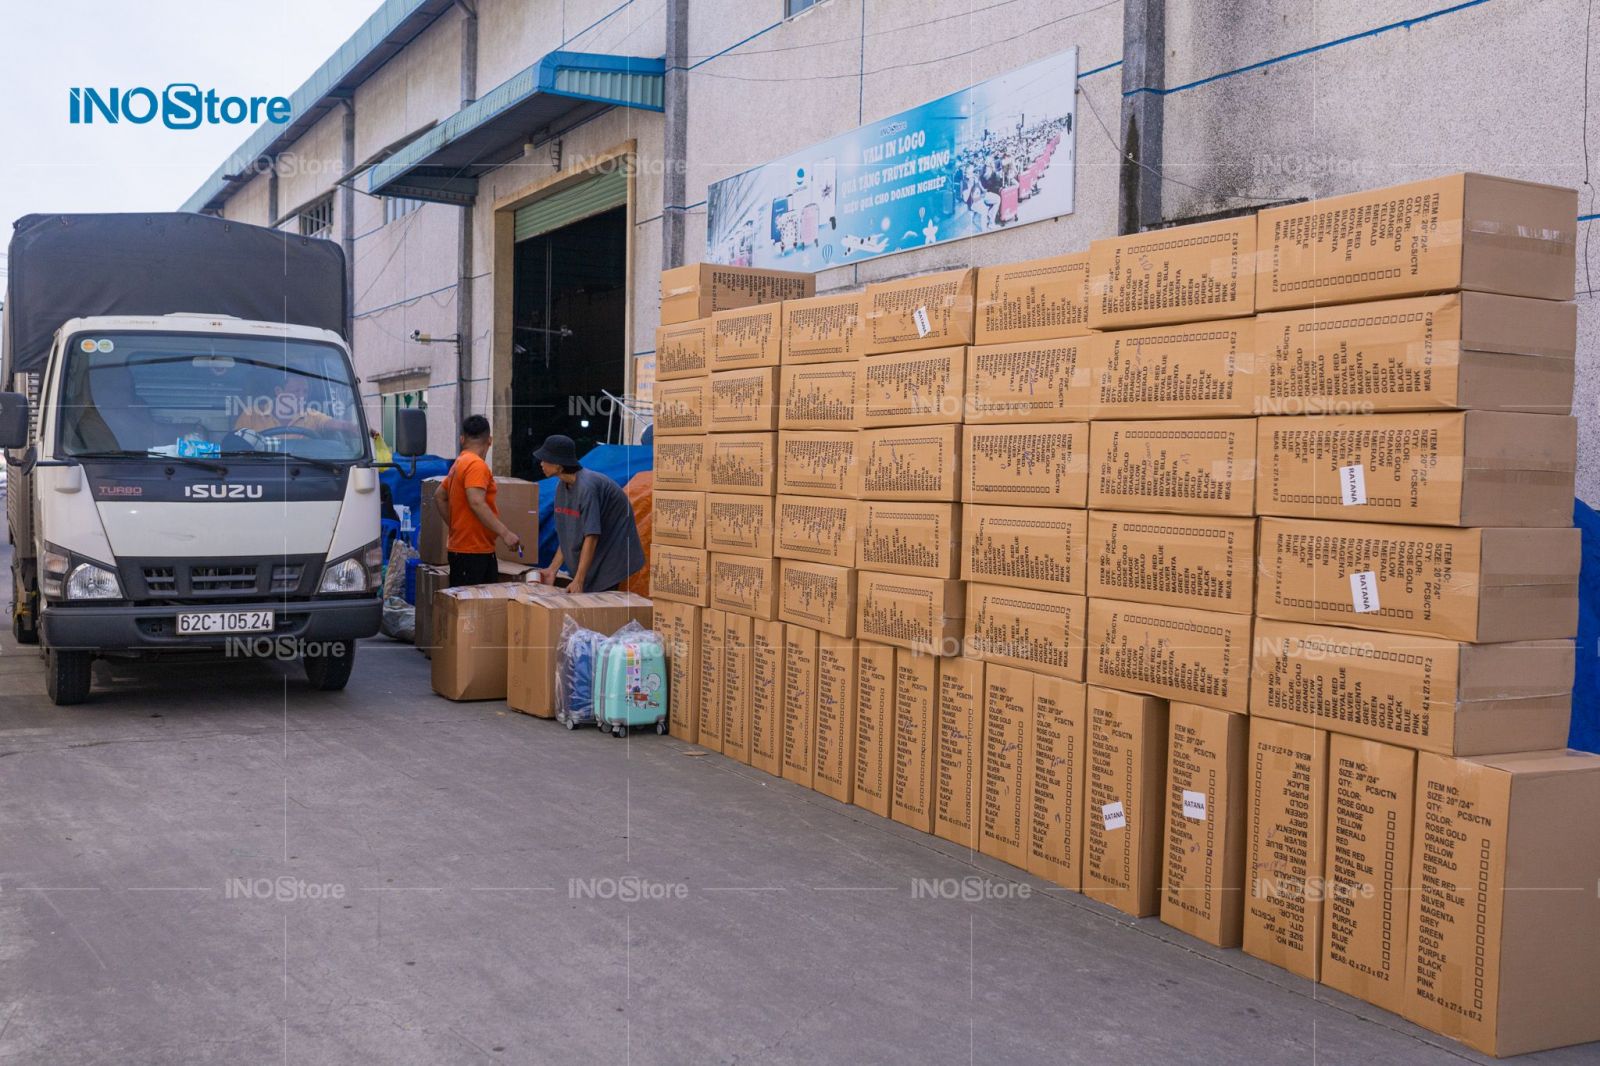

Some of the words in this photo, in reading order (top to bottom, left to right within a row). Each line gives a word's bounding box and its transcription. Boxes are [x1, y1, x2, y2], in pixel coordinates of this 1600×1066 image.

[863, 143, 884, 165] VALI
[885, 139, 897, 159] IN
[898, 129, 926, 154] LOGO
[874, 192, 890, 205] CHO
[890, 183, 916, 201] DOANH
[1431, 193, 1439, 216] ITEM
[1371, 204, 1379, 246] EMERALD
[1379, 202, 1387, 239] YELLOW
[1387, 201, 1396, 239] ORANGE
[99, 486, 142, 495] TURBO
[185, 484, 262, 498] ISUZU
[1348, 467, 1358, 504] RATANA
[1444, 544, 1452, 566] ITEM
[1360, 574, 1371, 611] RATANA
[1423, 581, 1431, 622] PCS/CTN
[180, 613, 271, 632] 62C-105.24
[1339, 758, 1354, 769] ITEM
[1366, 785, 1396, 800] PCS/CTN
[1428, 780, 1445, 792] ITEM
[1184, 801, 1205, 811] RATANA
[1337, 797, 1355, 809] ROSE
[1356, 802, 1375, 814] GOLD
[1104, 811, 1124, 822] RATANA
[1337, 807, 1364, 821] ORANGE
[1457, 810, 1491, 828] PCS/CTN
[1337, 817, 1363, 831] YELLOW
[1425, 822, 1445, 835] ROSE
[1446, 828, 1467, 842] GOLD
[1336, 826, 1366, 842] EMERALD
[1336, 836, 1348, 846] RED
[1425, 832, 1455, 849] ORANGE
[1335, 846, 1351, 857] WINE
[1352, 851, 1366, 862] RED
[1424, 843, 1454, 859] YELLOW
[1335, 855, 1355, 869] ROYAL
[1357, 862, 1373, 874] BLUE
[1423, 863, 1437, 875] RED
[1424, 853, 1458, 871] EMERALD
[1334, 865, 1356, 879] SILVER
[1334, 875, 1364, 891] MAGENTA
[1423, 874, 1440, 887] WINE
[1442, 880, 1457, 892] RED
[1333, 894, 1355, 908] GREEN
[1421, 895, 1445, 910] SILVER
[1422, 884, 1444, 899] ROYAL
[1446, 892, 1465, 906] BLUE
[1333, 903, 1350, 916] GOLD
[1421, 905, 1455, 924] MAGENTA
[1333, 913, 1357, 928] PURPLE
[1420, 915, 1439, 929] GREY
[1332, 922, 1353, 937] BLACK
[1420, 925, 1444, 941] GREEN
[1332, 932, 1348, 944] BLUE
[1419, 935, 1439, 950] GOLD
[1332, 941, 1346, 953] PINK
[1419, 946, 1446, 963] PURPLE
[1418, 956, 1442, 972] BLACK
[1418, 966, 1436, 980] BLUE
[1417, 976, 1433, 990] PINK
